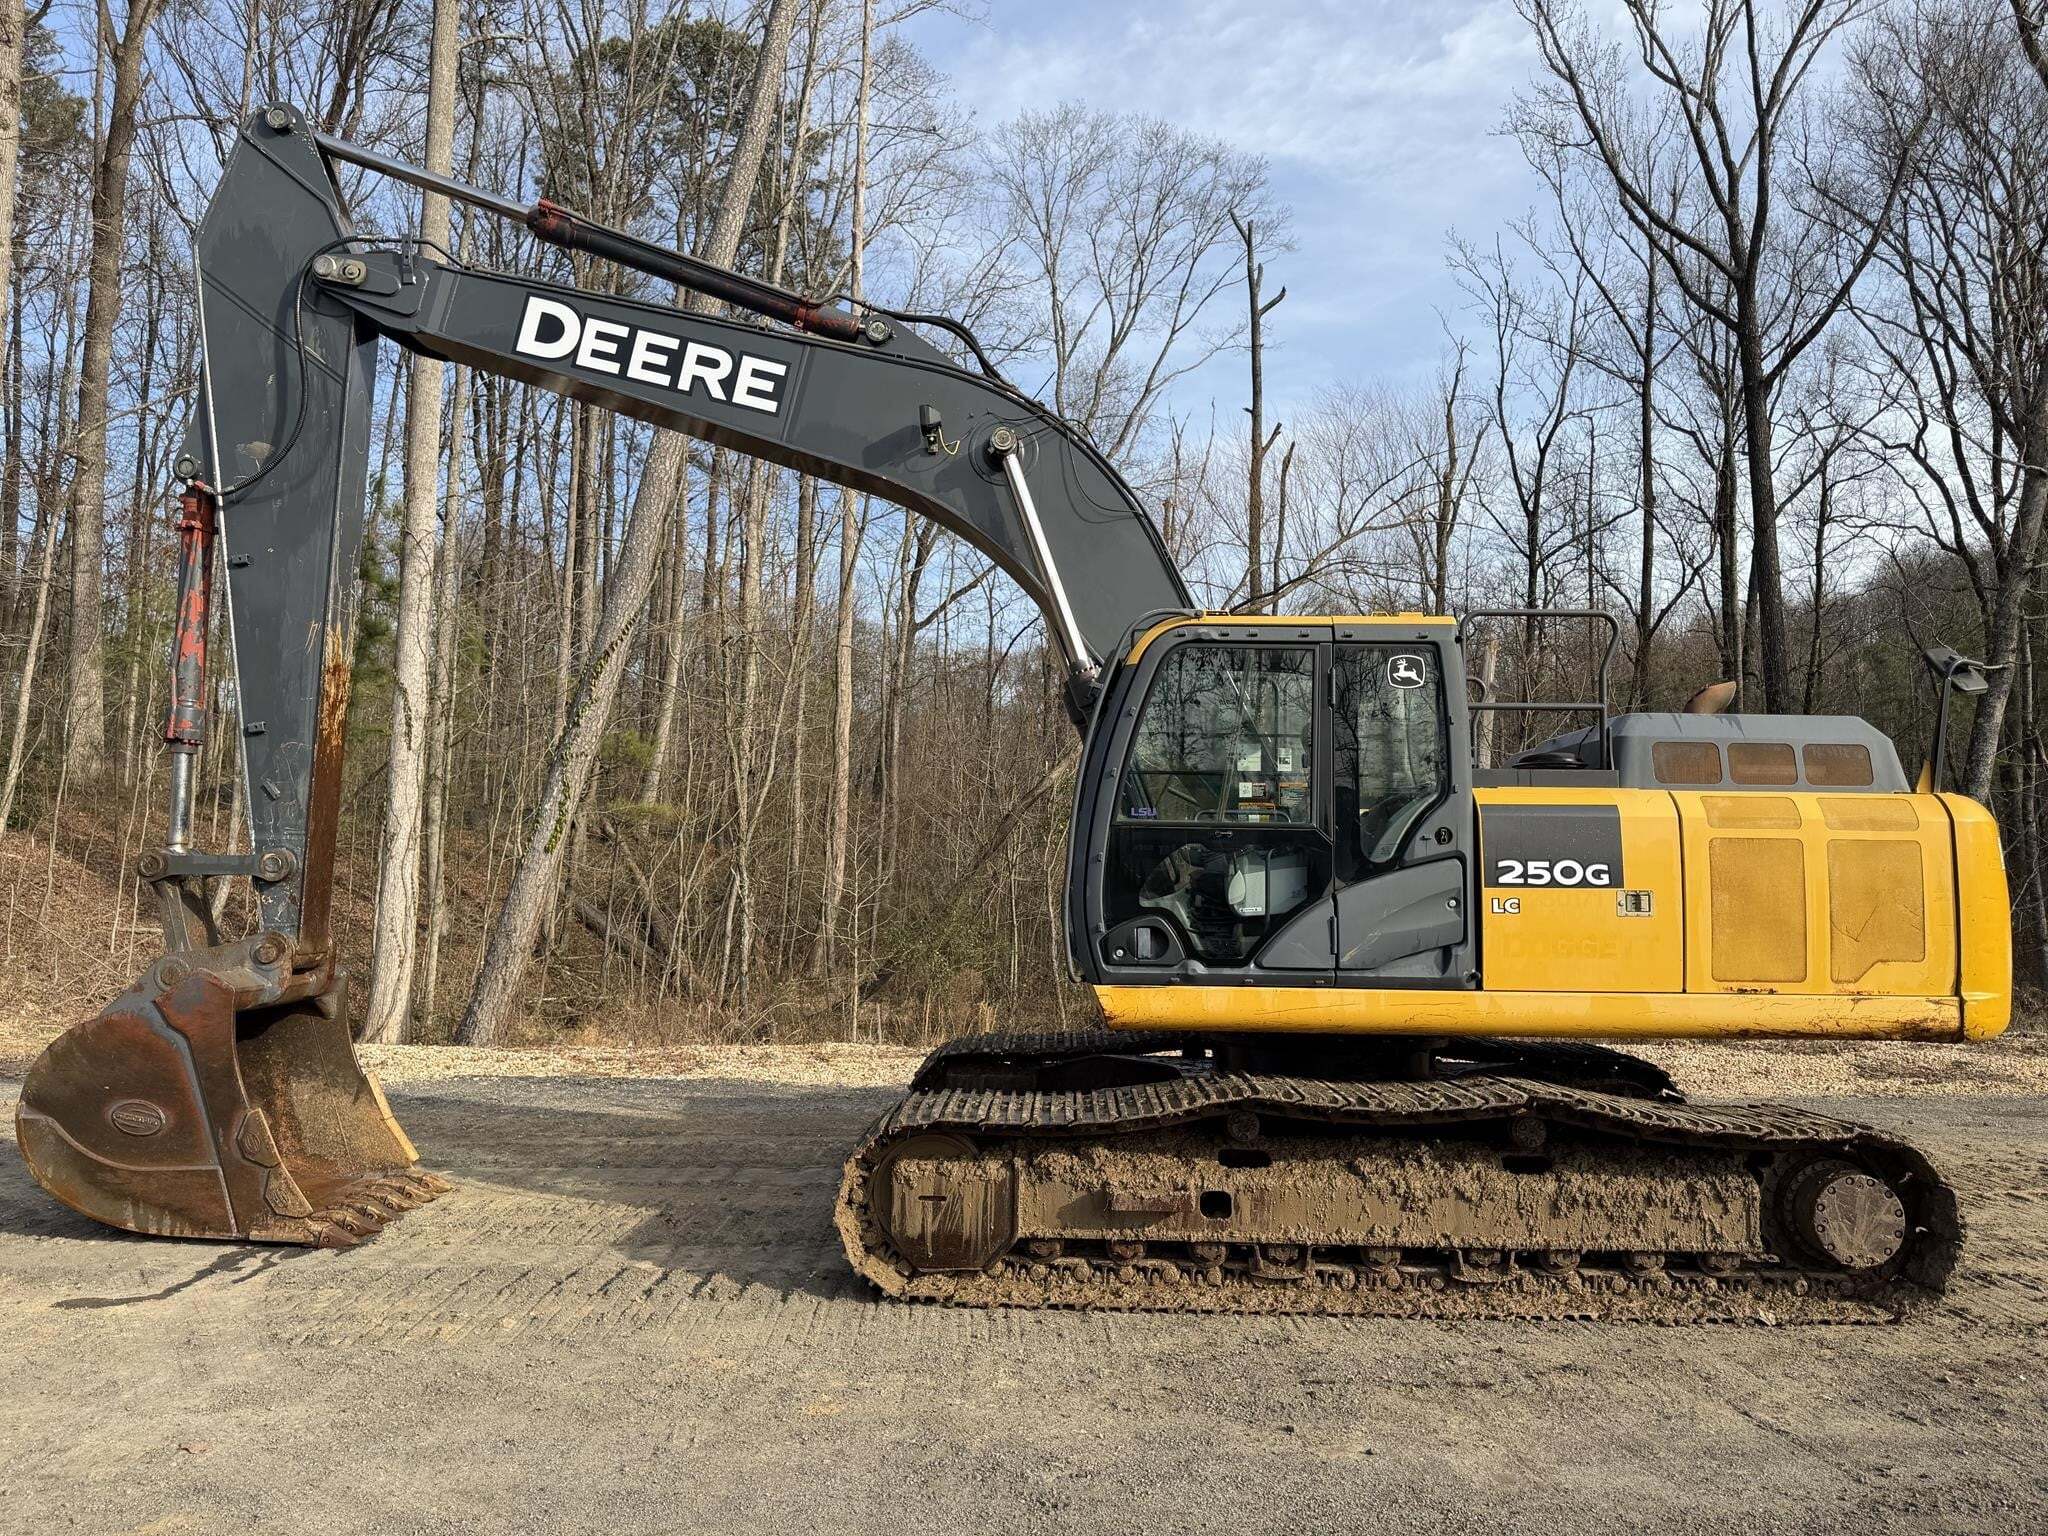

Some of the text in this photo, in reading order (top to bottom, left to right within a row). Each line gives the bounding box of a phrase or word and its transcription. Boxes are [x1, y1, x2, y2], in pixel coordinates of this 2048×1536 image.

[516, 296, 787, 413] DEERE
[1497, 859, 1610, 886] 250G
[1491, 898, 1520, 914] LC
